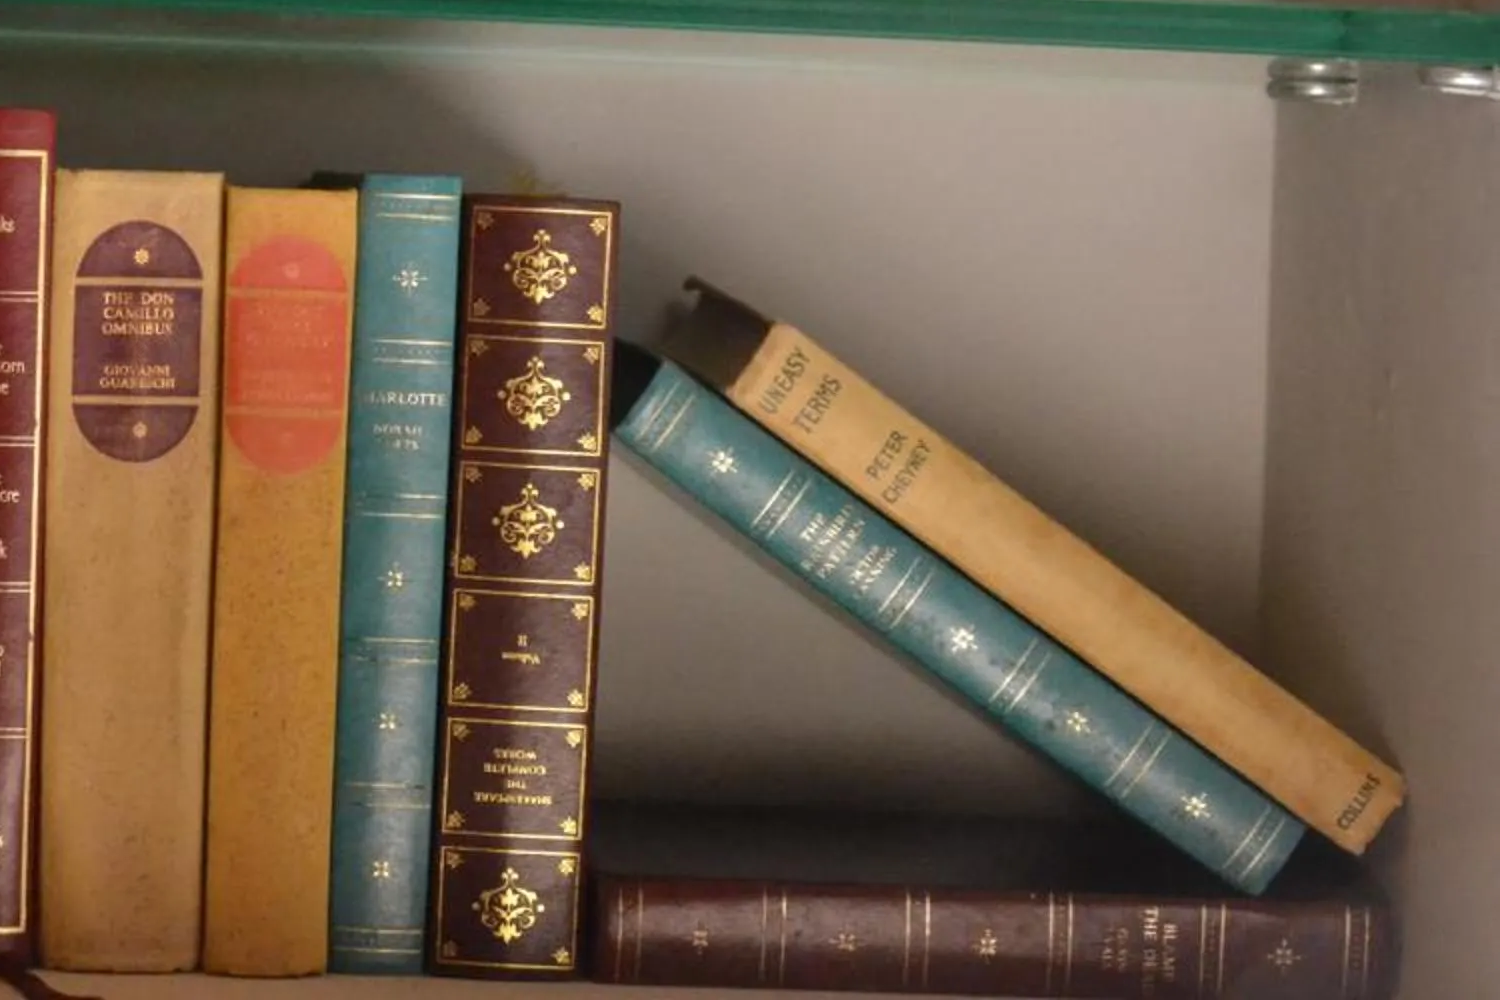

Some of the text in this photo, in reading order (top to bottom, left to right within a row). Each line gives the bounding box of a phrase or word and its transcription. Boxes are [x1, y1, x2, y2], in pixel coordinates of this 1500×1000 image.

[102, 291, 175, 306] THE DON
[103, 307, 175, 320] CAMILLO
[101, 321, 174, 335] OMNIBUS
[758, 348, 810, 414] UNEASY
[793, 374, 843, 434] TERMS
[865, 430, 909, 480] PETER
[881, 439, 932, 504] CHEYNEY
[800, 513, 825, 541] THE
[1337, 773, 1381, 830] COLLINS
[1143, 906, 1159, 941] THE
